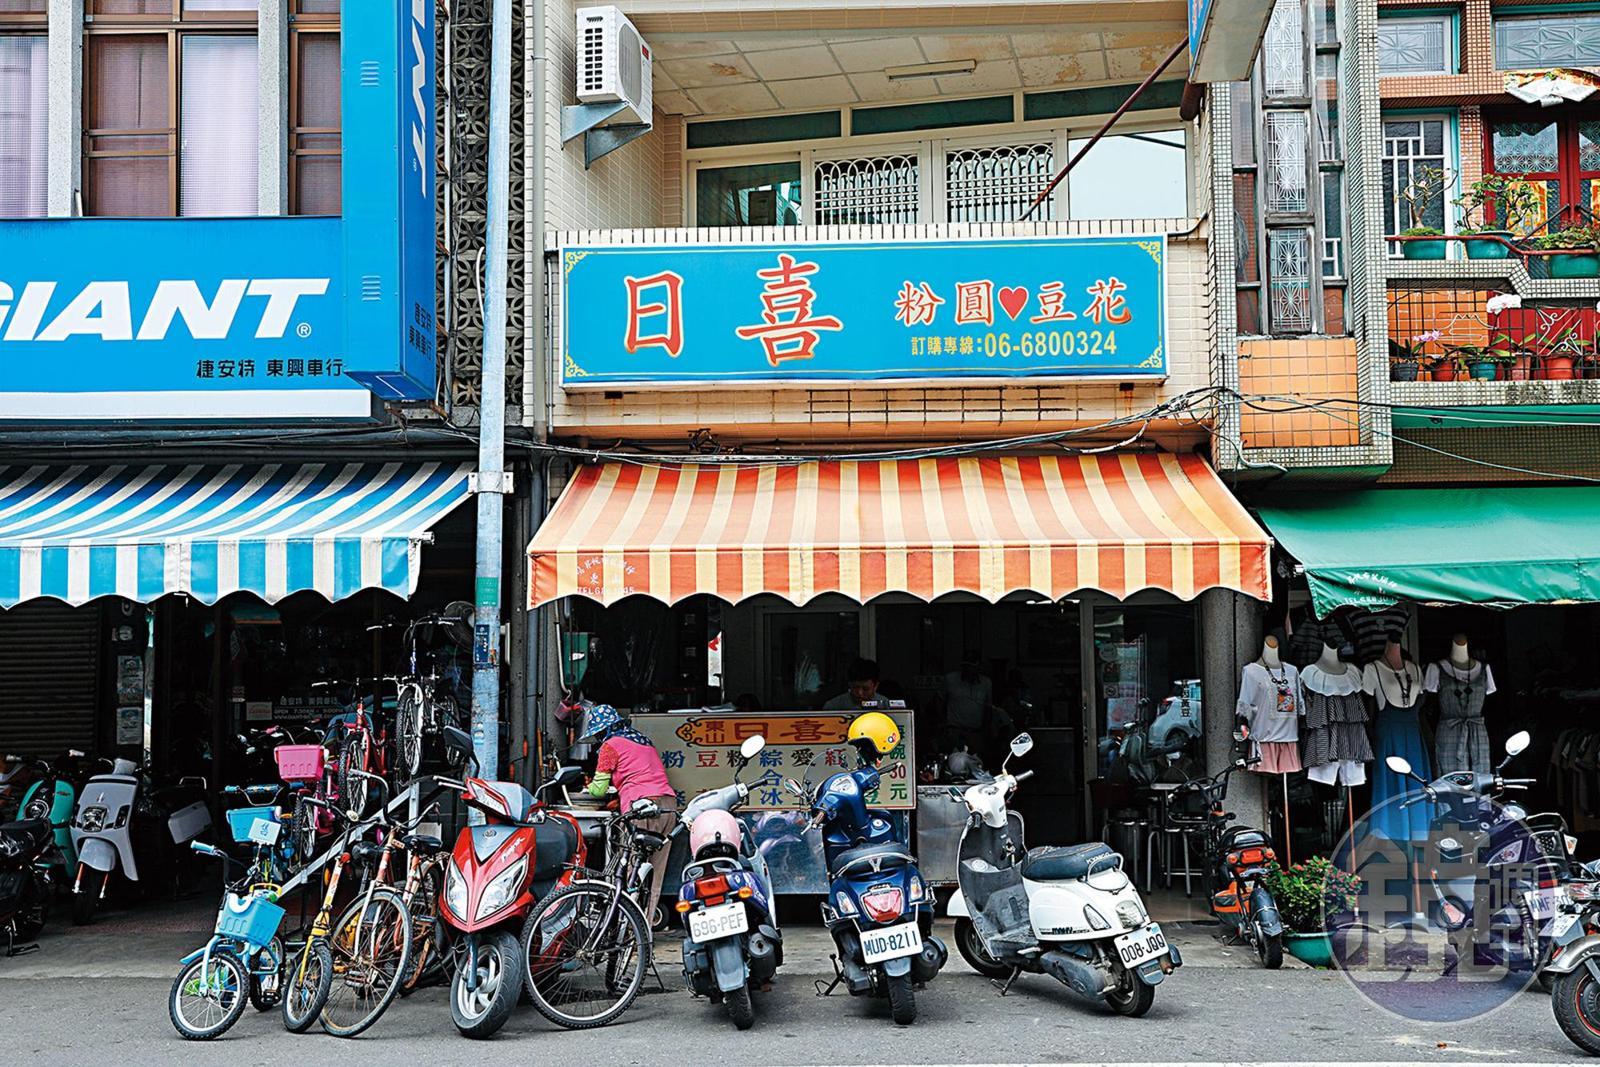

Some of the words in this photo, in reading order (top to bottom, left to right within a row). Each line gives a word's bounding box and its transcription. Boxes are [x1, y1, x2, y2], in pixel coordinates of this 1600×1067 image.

[894, 280, 995, 327] 粉圓
[1030, 276, 1133, 325] 豆花
[267, 358, 343, 377] 東興車行
[705, 720, 725, 744] 東山
[759, 749, 784, 806] 綜合冰
